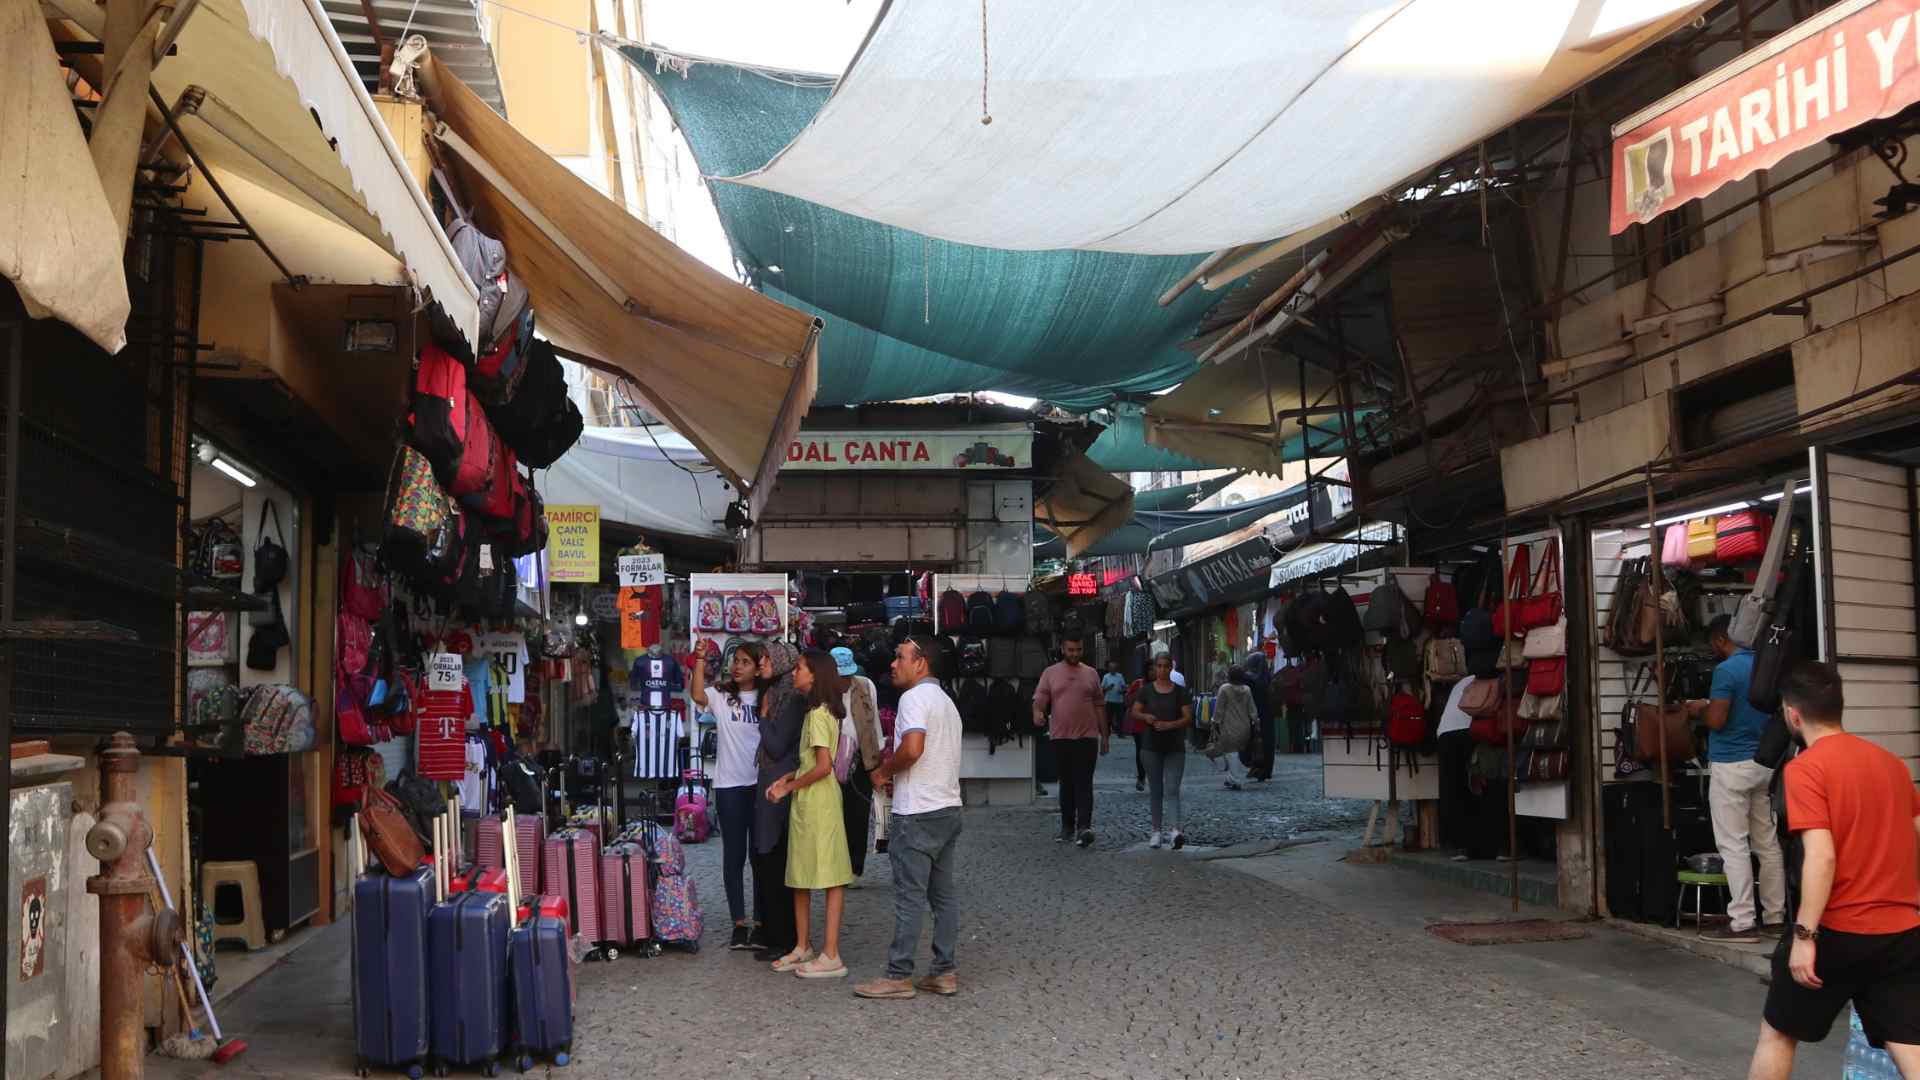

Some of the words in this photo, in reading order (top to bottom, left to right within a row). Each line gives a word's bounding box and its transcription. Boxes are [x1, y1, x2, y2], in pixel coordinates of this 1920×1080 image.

[1680, 32, 1848, 177] TARİHİ
[844, 441, 930, 464] ÇANTA
[620, 563, 662, 572] FORMALAR
[438, 717, 456, 740] T
